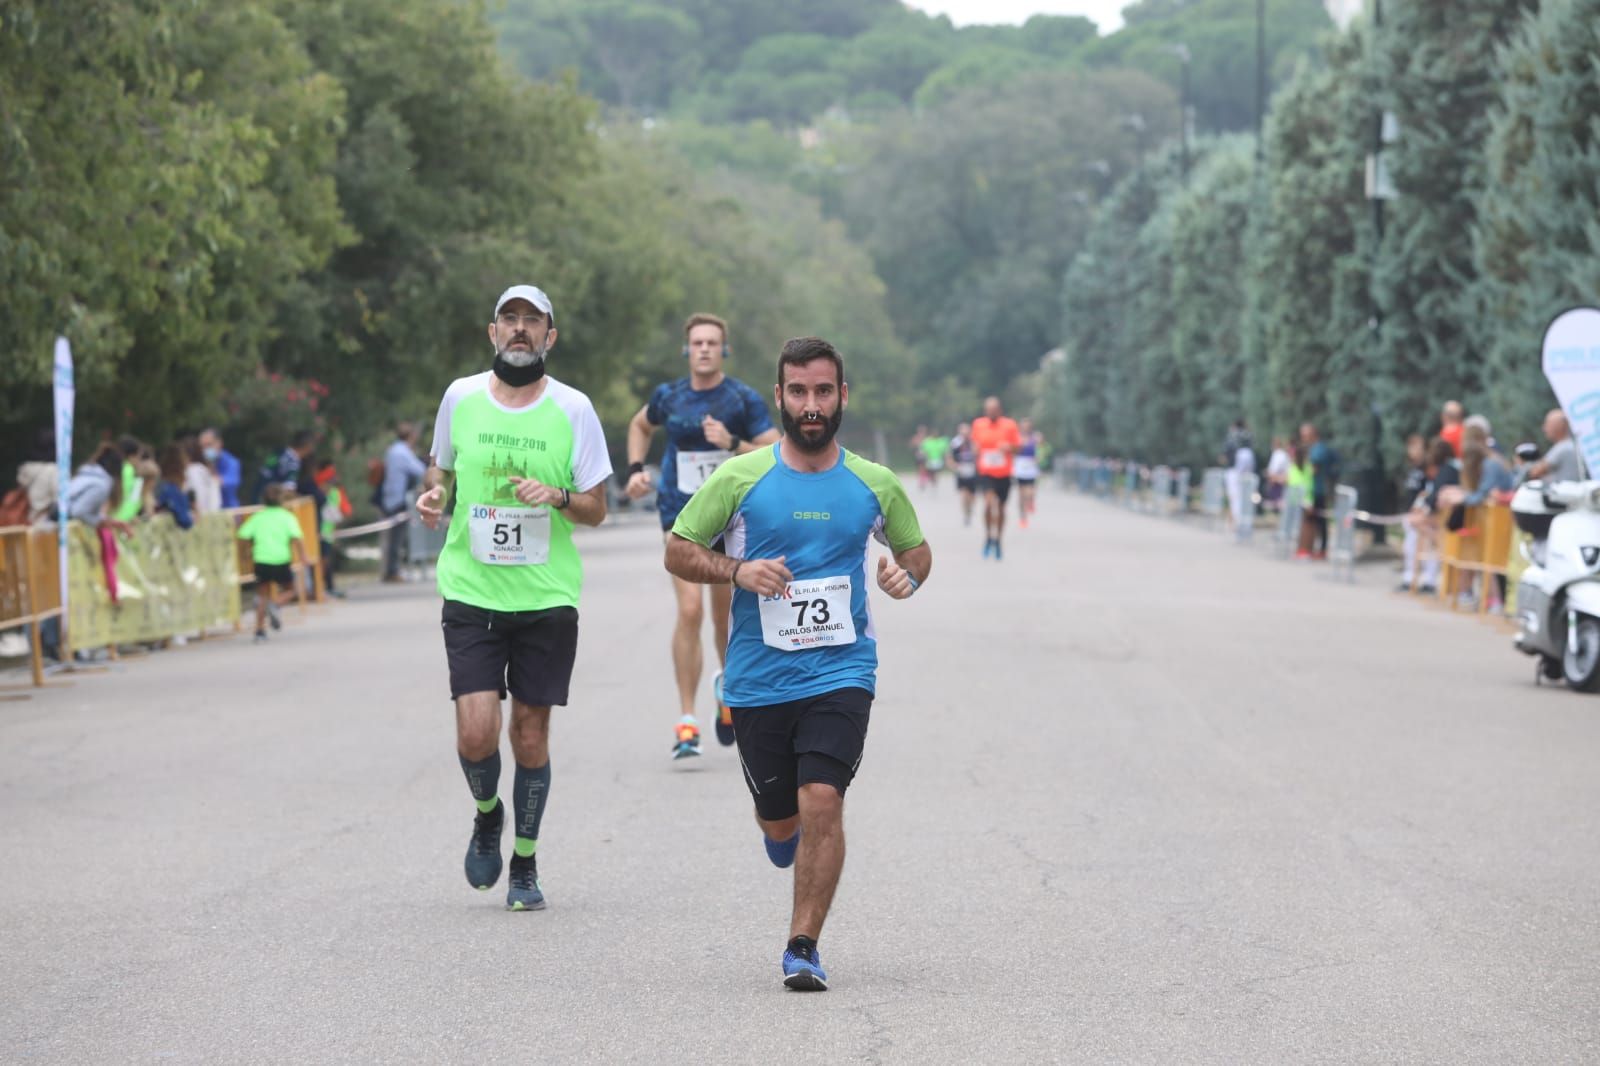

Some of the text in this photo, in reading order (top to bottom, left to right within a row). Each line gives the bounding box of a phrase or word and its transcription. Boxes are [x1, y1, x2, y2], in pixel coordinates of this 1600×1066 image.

[478, 433, 547, 452] 10K Pilar 2018
[472, 507, 497, 520] 10K
[493, 523, 521, 545] 51
[791, 598, 830, 627] 73
[778, 623, 844, 637] CARLOS MANUEL
